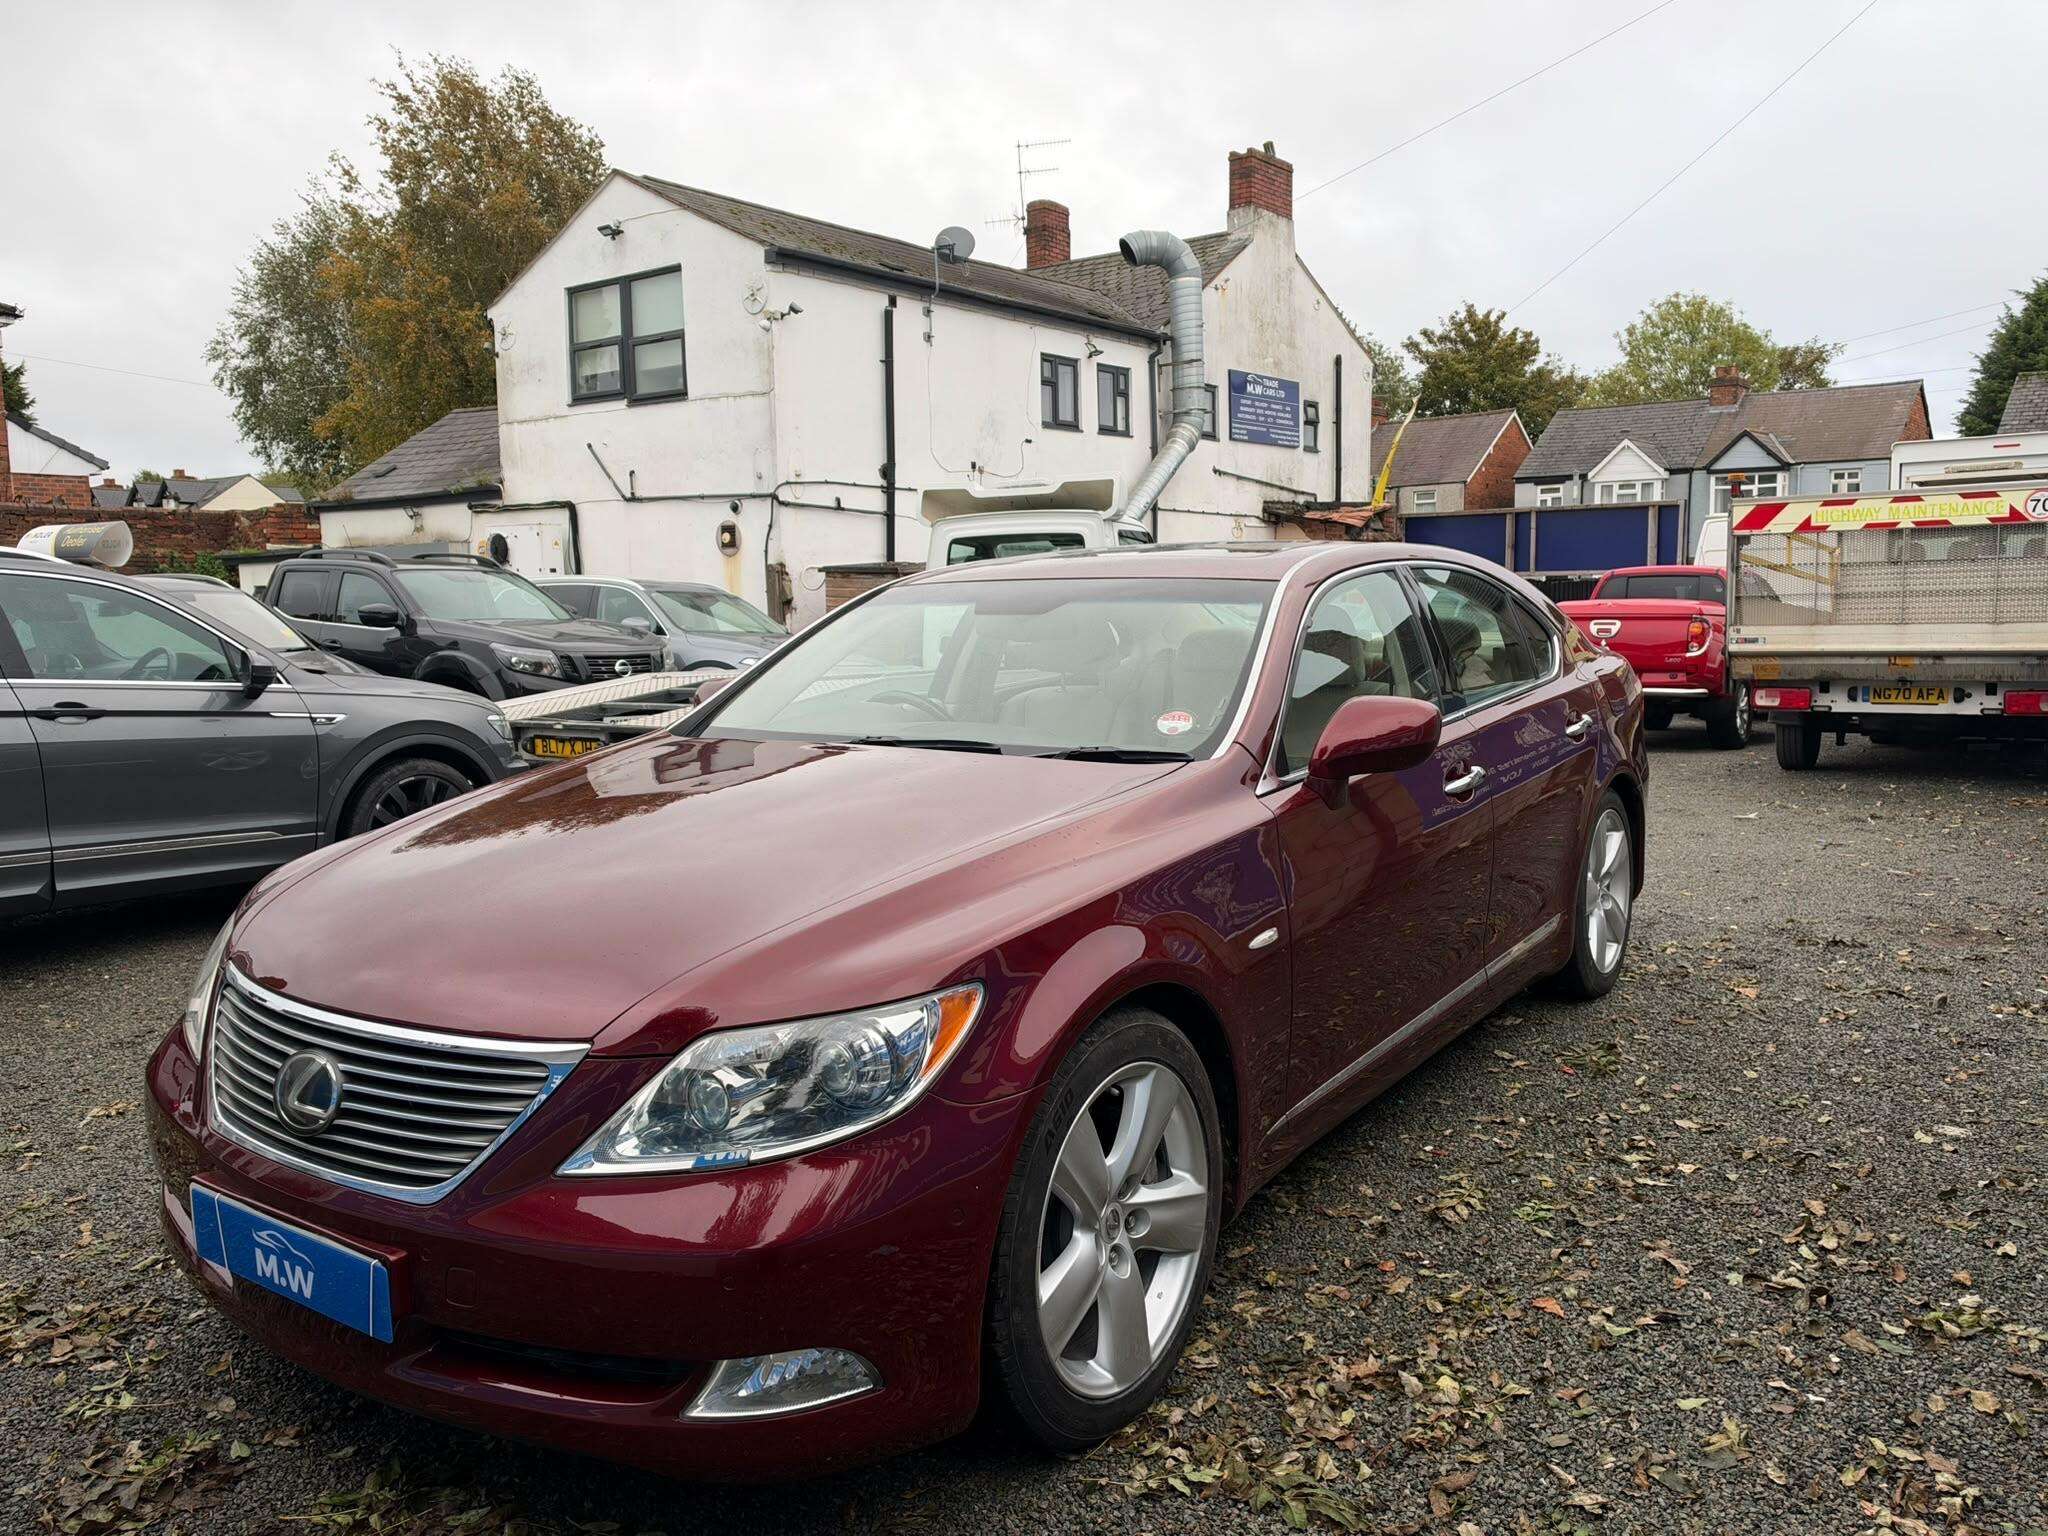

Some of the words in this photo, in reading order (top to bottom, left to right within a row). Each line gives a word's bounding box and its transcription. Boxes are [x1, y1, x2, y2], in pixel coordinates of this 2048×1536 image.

[1246, 383, 1263, 395] M.W
[1815, 507, 1882, 522] HIGHWAY
[1888, 500, 2004, 519] MAINTENANCE
[1873, 688, 1911, 699] NG70
[1917, 688, 1945, 700] AFA
[542, 740, 566, 754] BL17
[255, 1247, 314, 1299] M.W
